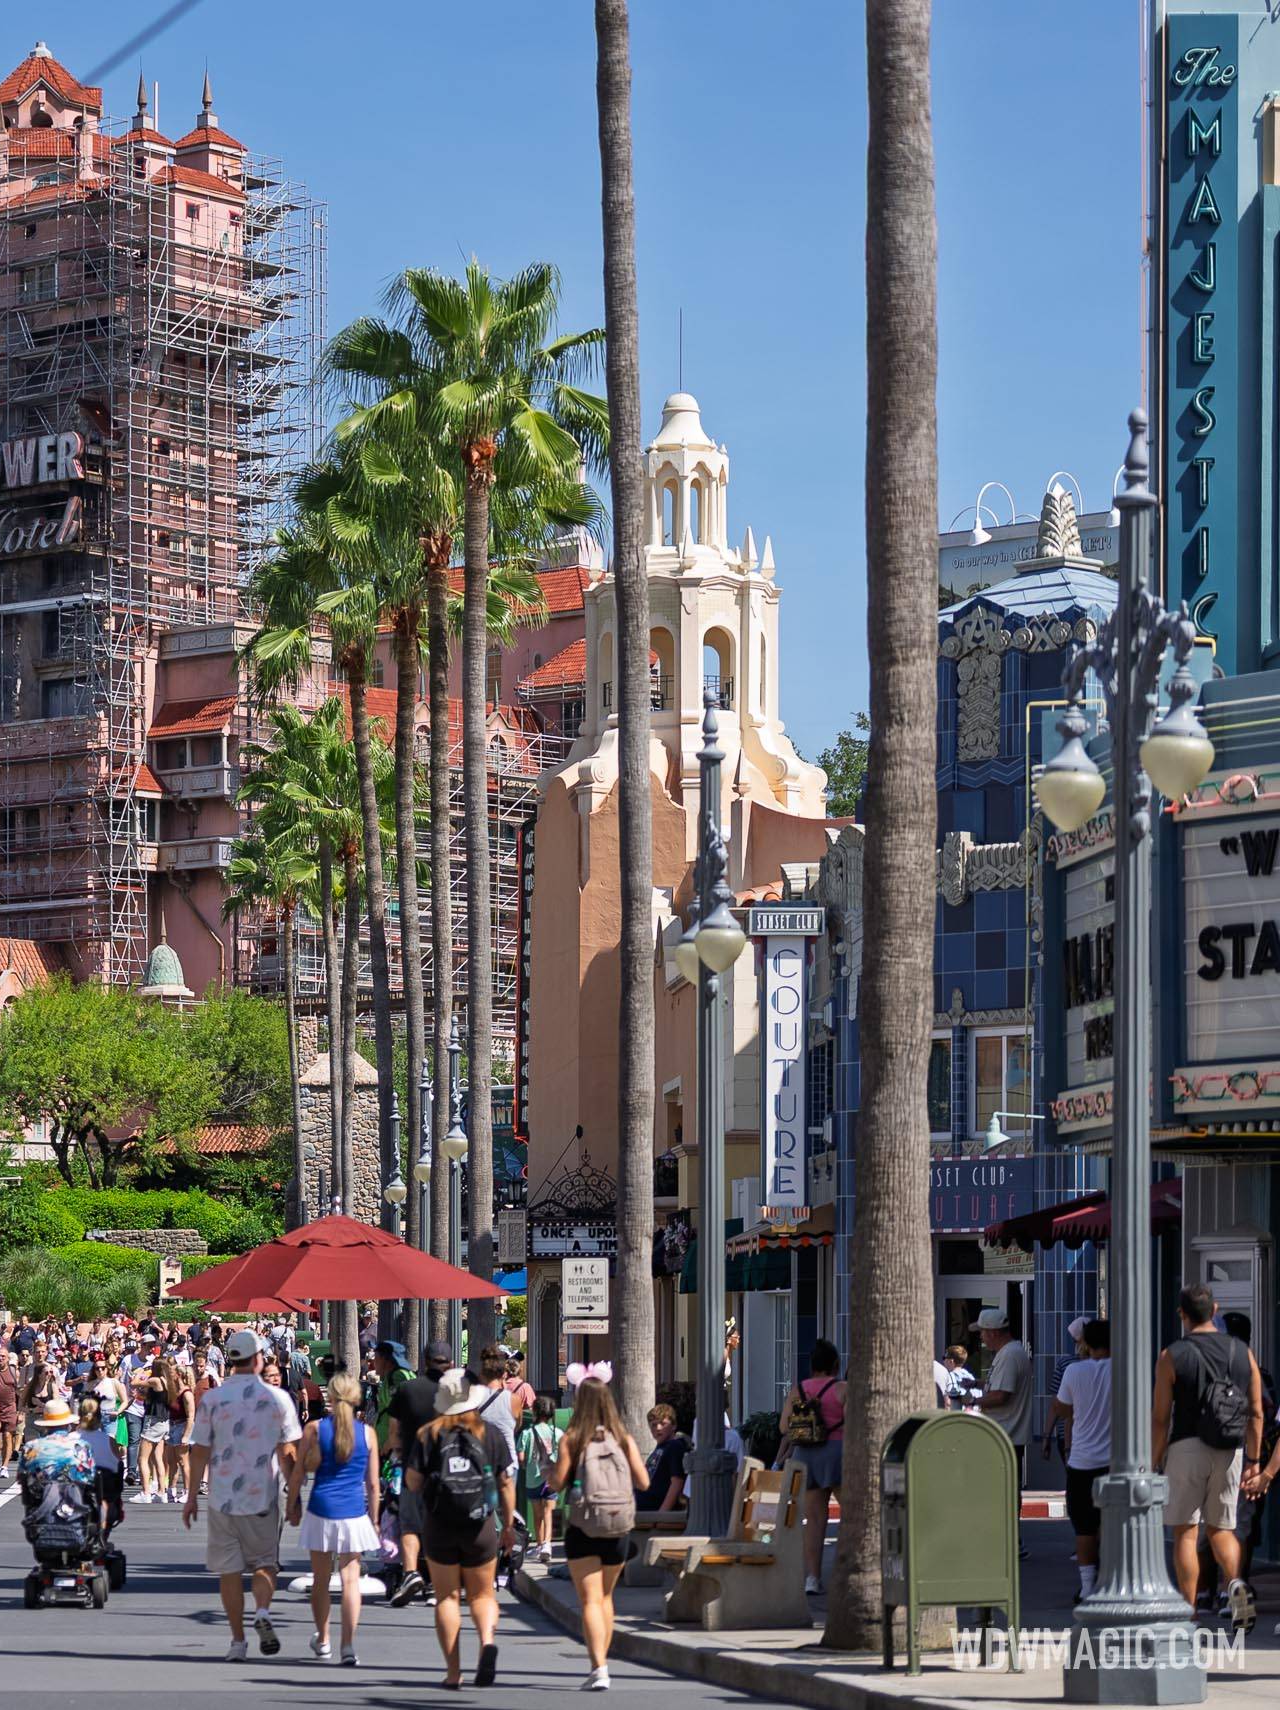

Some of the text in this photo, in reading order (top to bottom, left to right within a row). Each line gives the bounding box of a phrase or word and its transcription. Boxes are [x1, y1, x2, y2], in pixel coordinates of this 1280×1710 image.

[1172, 46, 1239, 88] The
[1188, 106, 1220, 638] MAJESTIC
[952, 559, 965, 569] On
[757, 911, 819, 931] SUNSET CLUB
[771, 949, 800, 1194] COUTURE
[936, 1194, 1015, 1221] UTURE
[541, 1227, 574, 1239] ONCE
[572, 1240, 618, 1251] A TIM
[568, 1277, 604, 1286] RESTROOMS
[579, 1287, 592, 1295] AND
[568, 1295, 604, 1304] TELEPHONES
